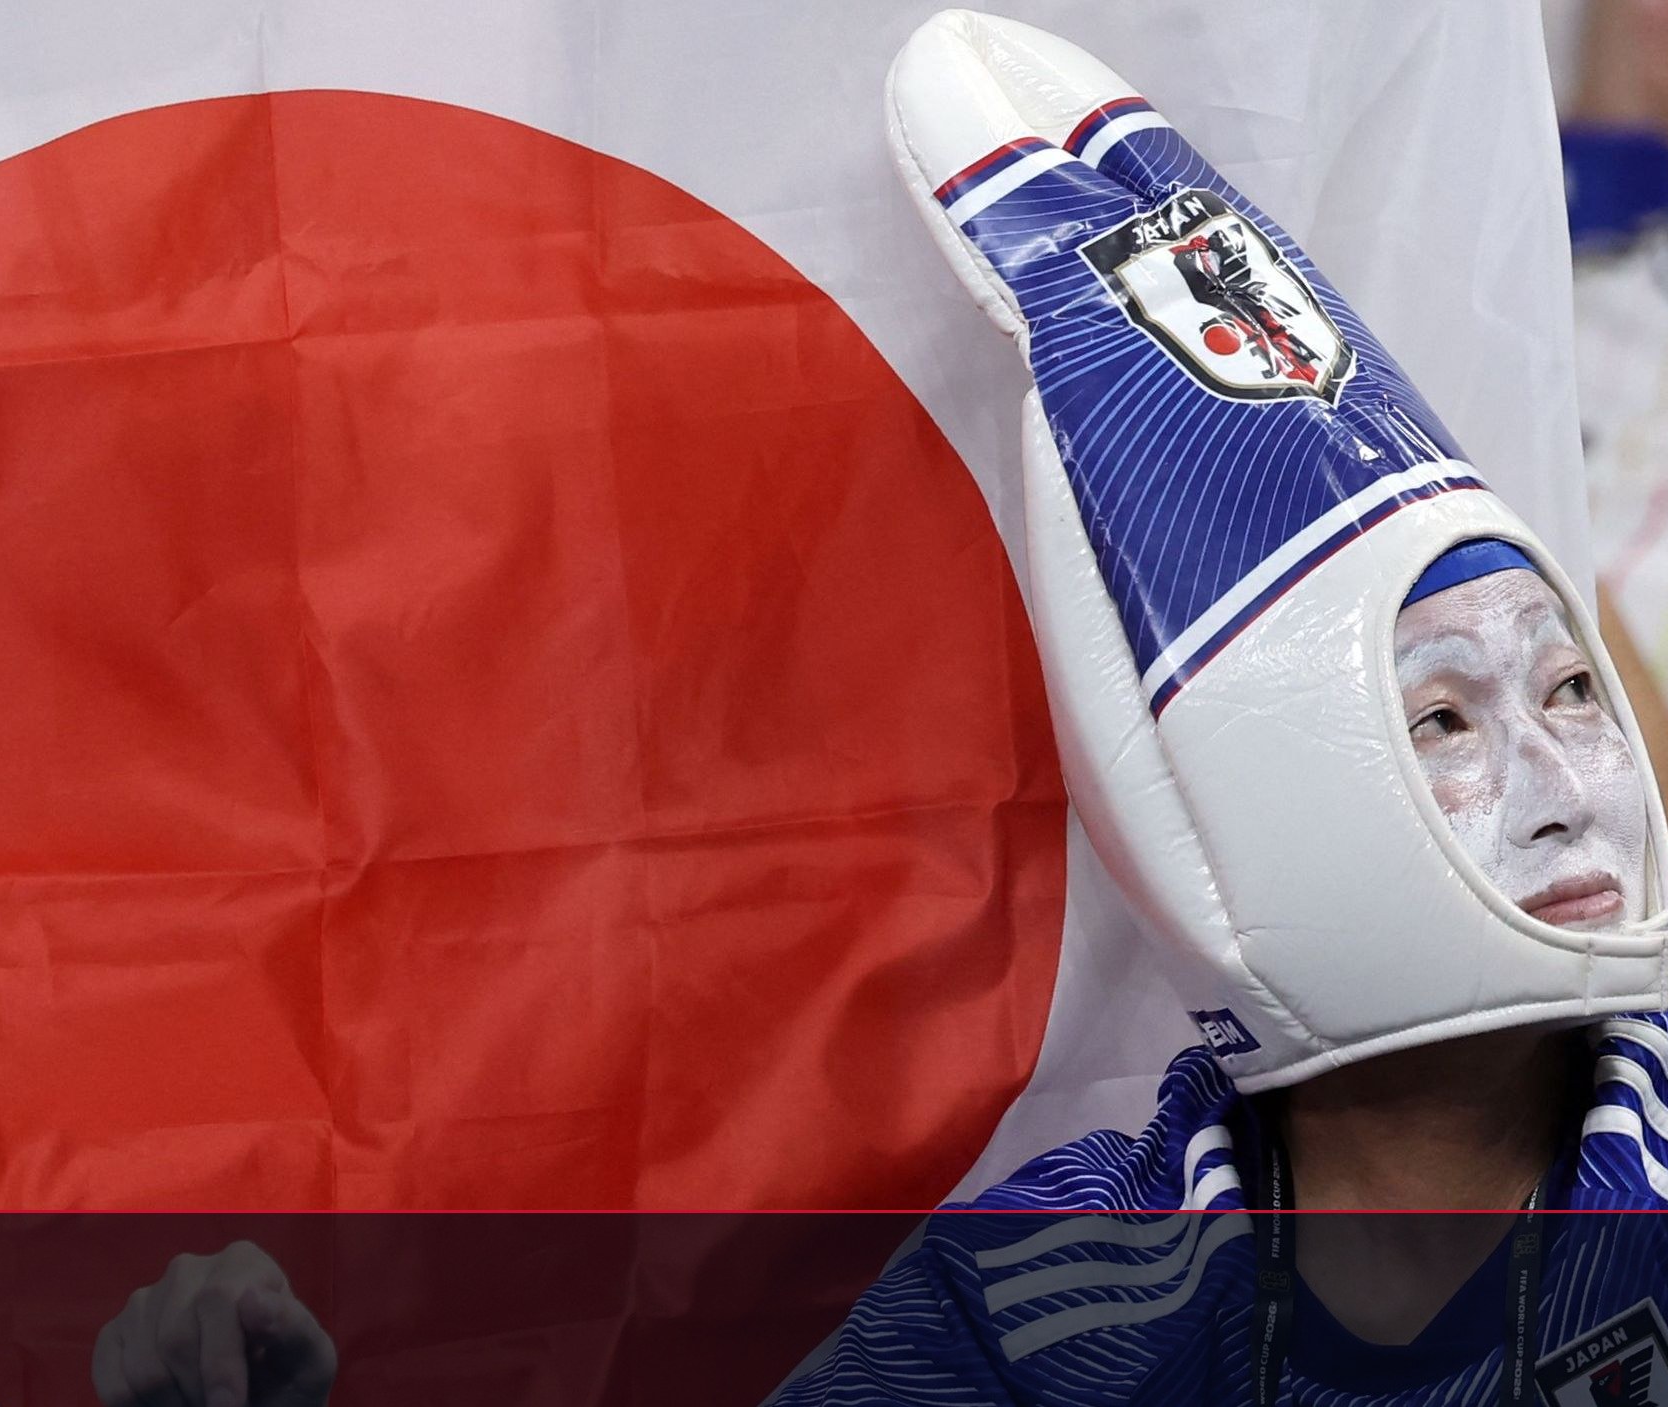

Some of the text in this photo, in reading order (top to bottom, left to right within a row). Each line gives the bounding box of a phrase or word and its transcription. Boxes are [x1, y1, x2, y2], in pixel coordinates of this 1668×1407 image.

[1271, 1237, 1281, 1259] FIFA
[1519, 1269, 1528, 1293] FIFA
[1517, 1294, 1526, 1334] WORLD
[1260, 1343, 1270, 1365] CUP
[1516, 1335, 1525, 1358] CUP
[1565, 1326, 1629, 1373] JAPAN
